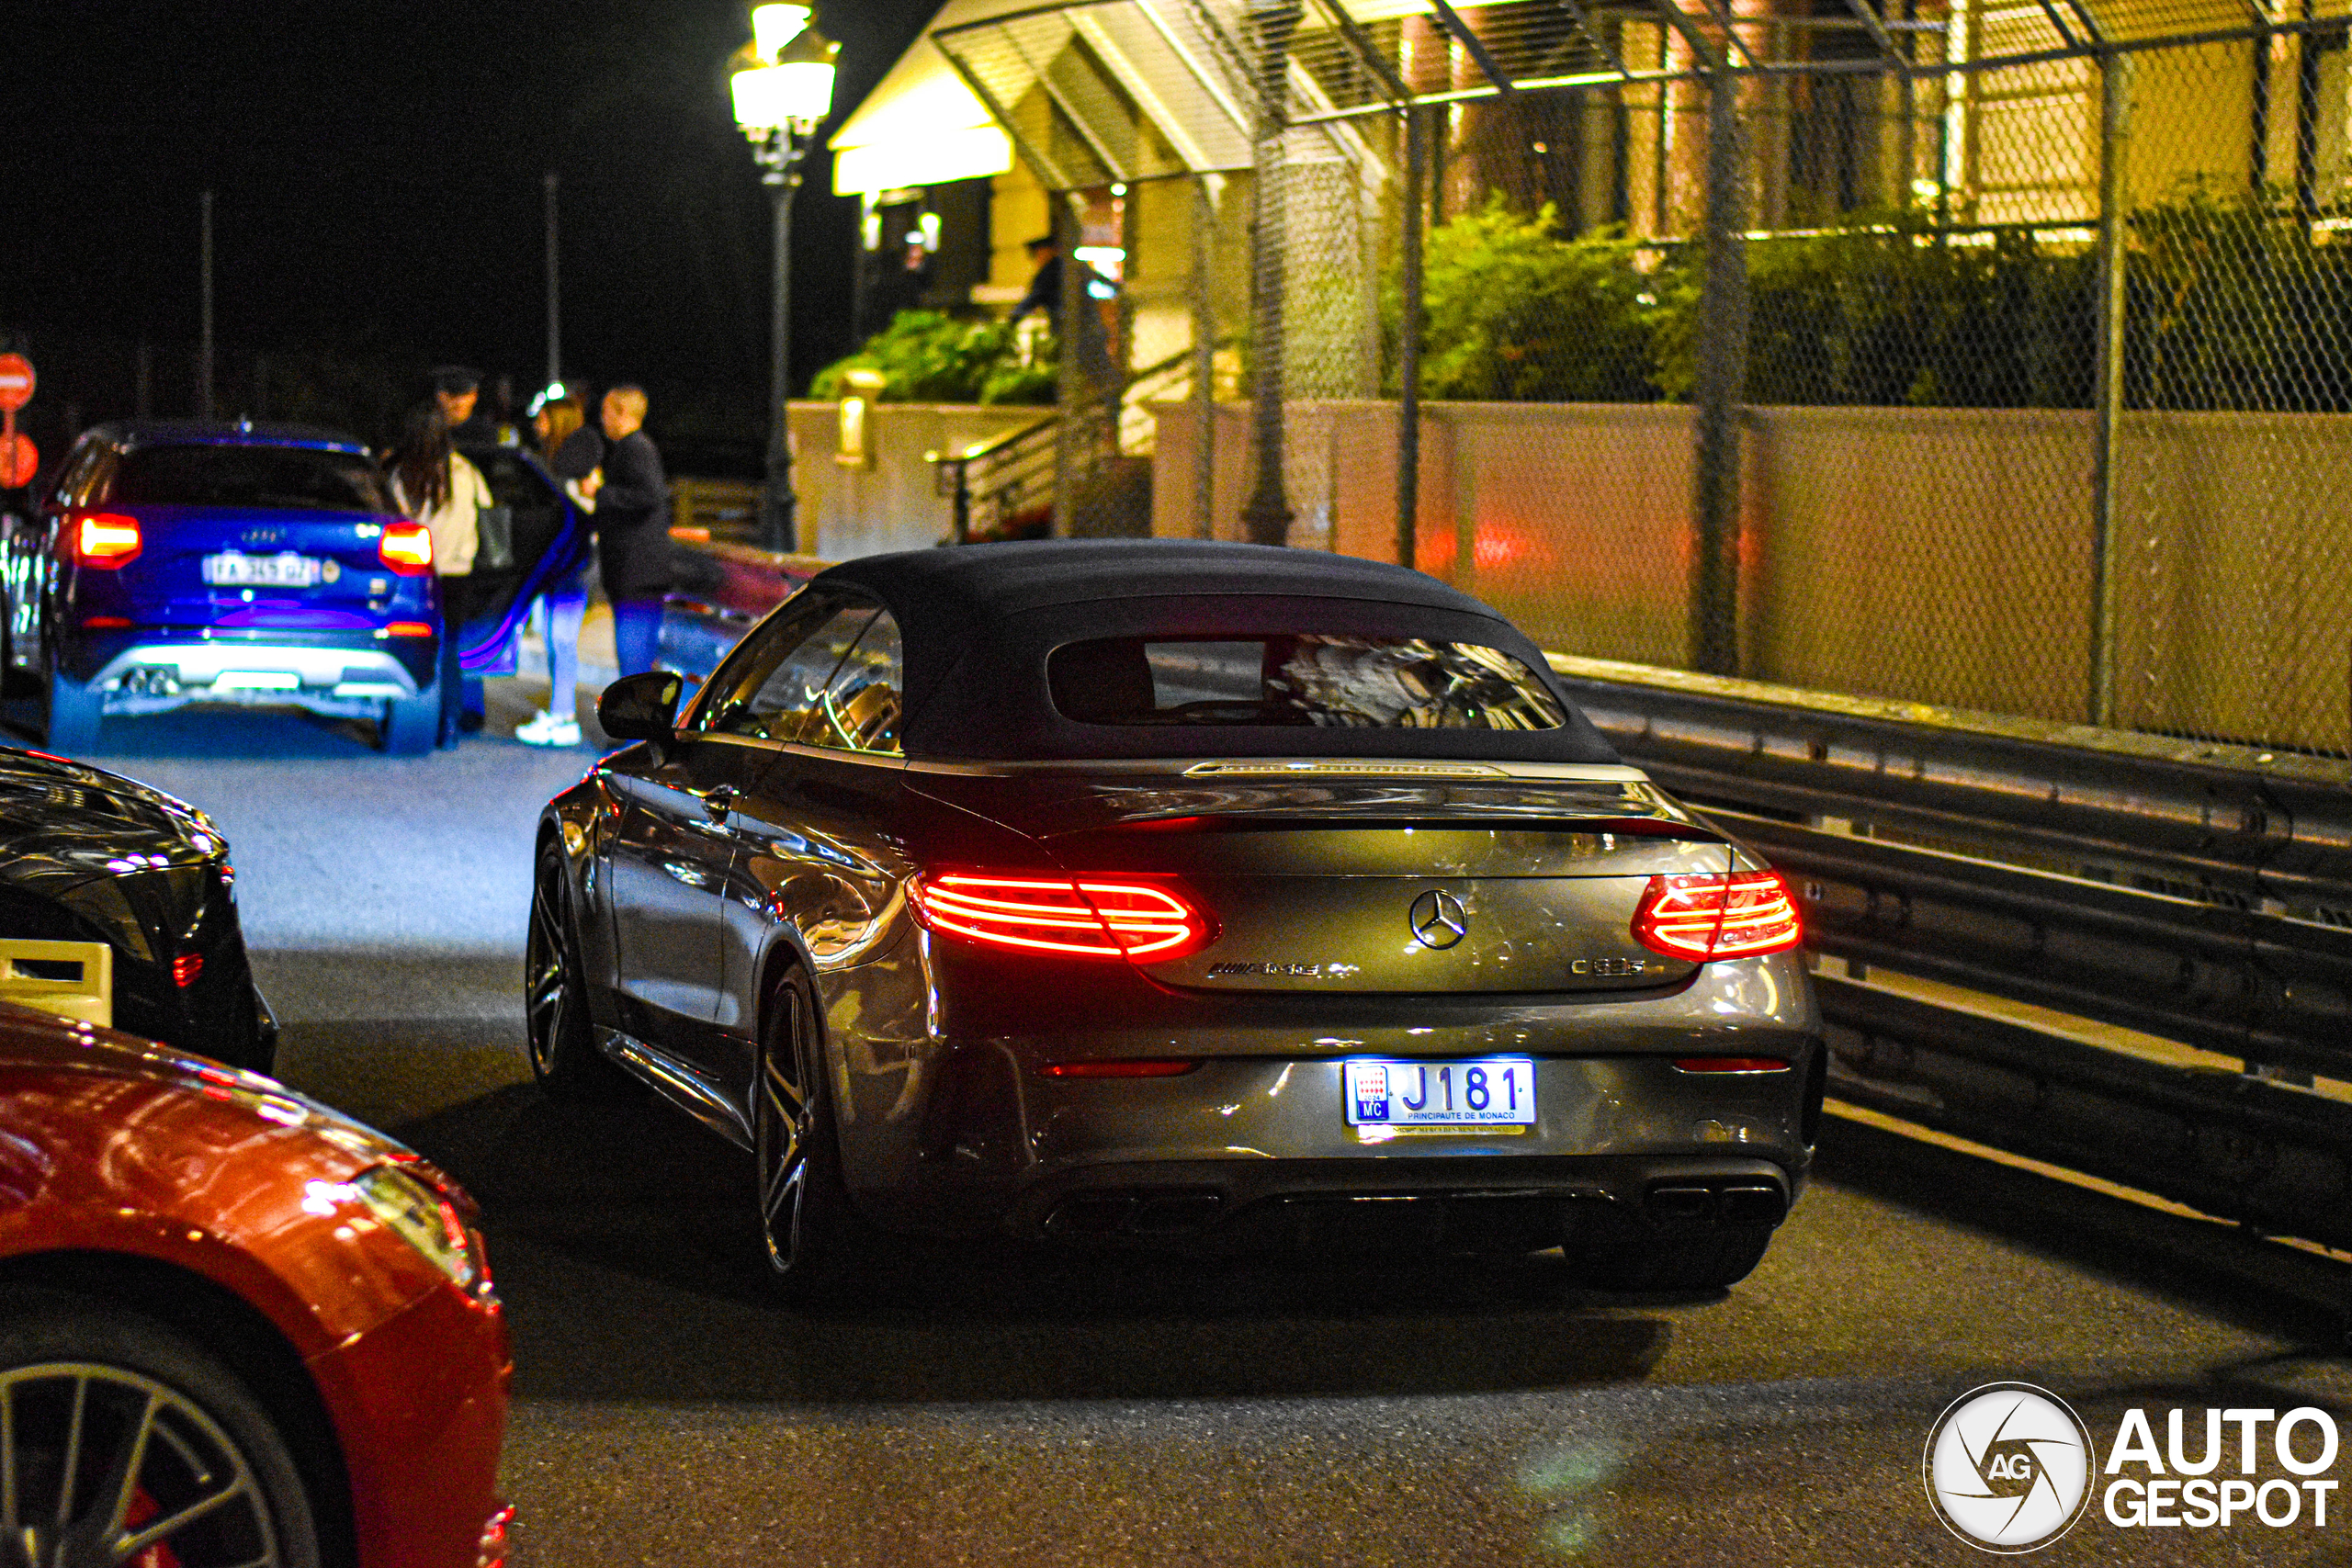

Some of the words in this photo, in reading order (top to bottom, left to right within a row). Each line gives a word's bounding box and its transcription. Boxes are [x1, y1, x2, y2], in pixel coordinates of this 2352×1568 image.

[1402, 1066, 1516, 1111] J181
[1363, 1102, 1382, 1116] MC
[1478, 1111, 1515, 1120] MONACO
